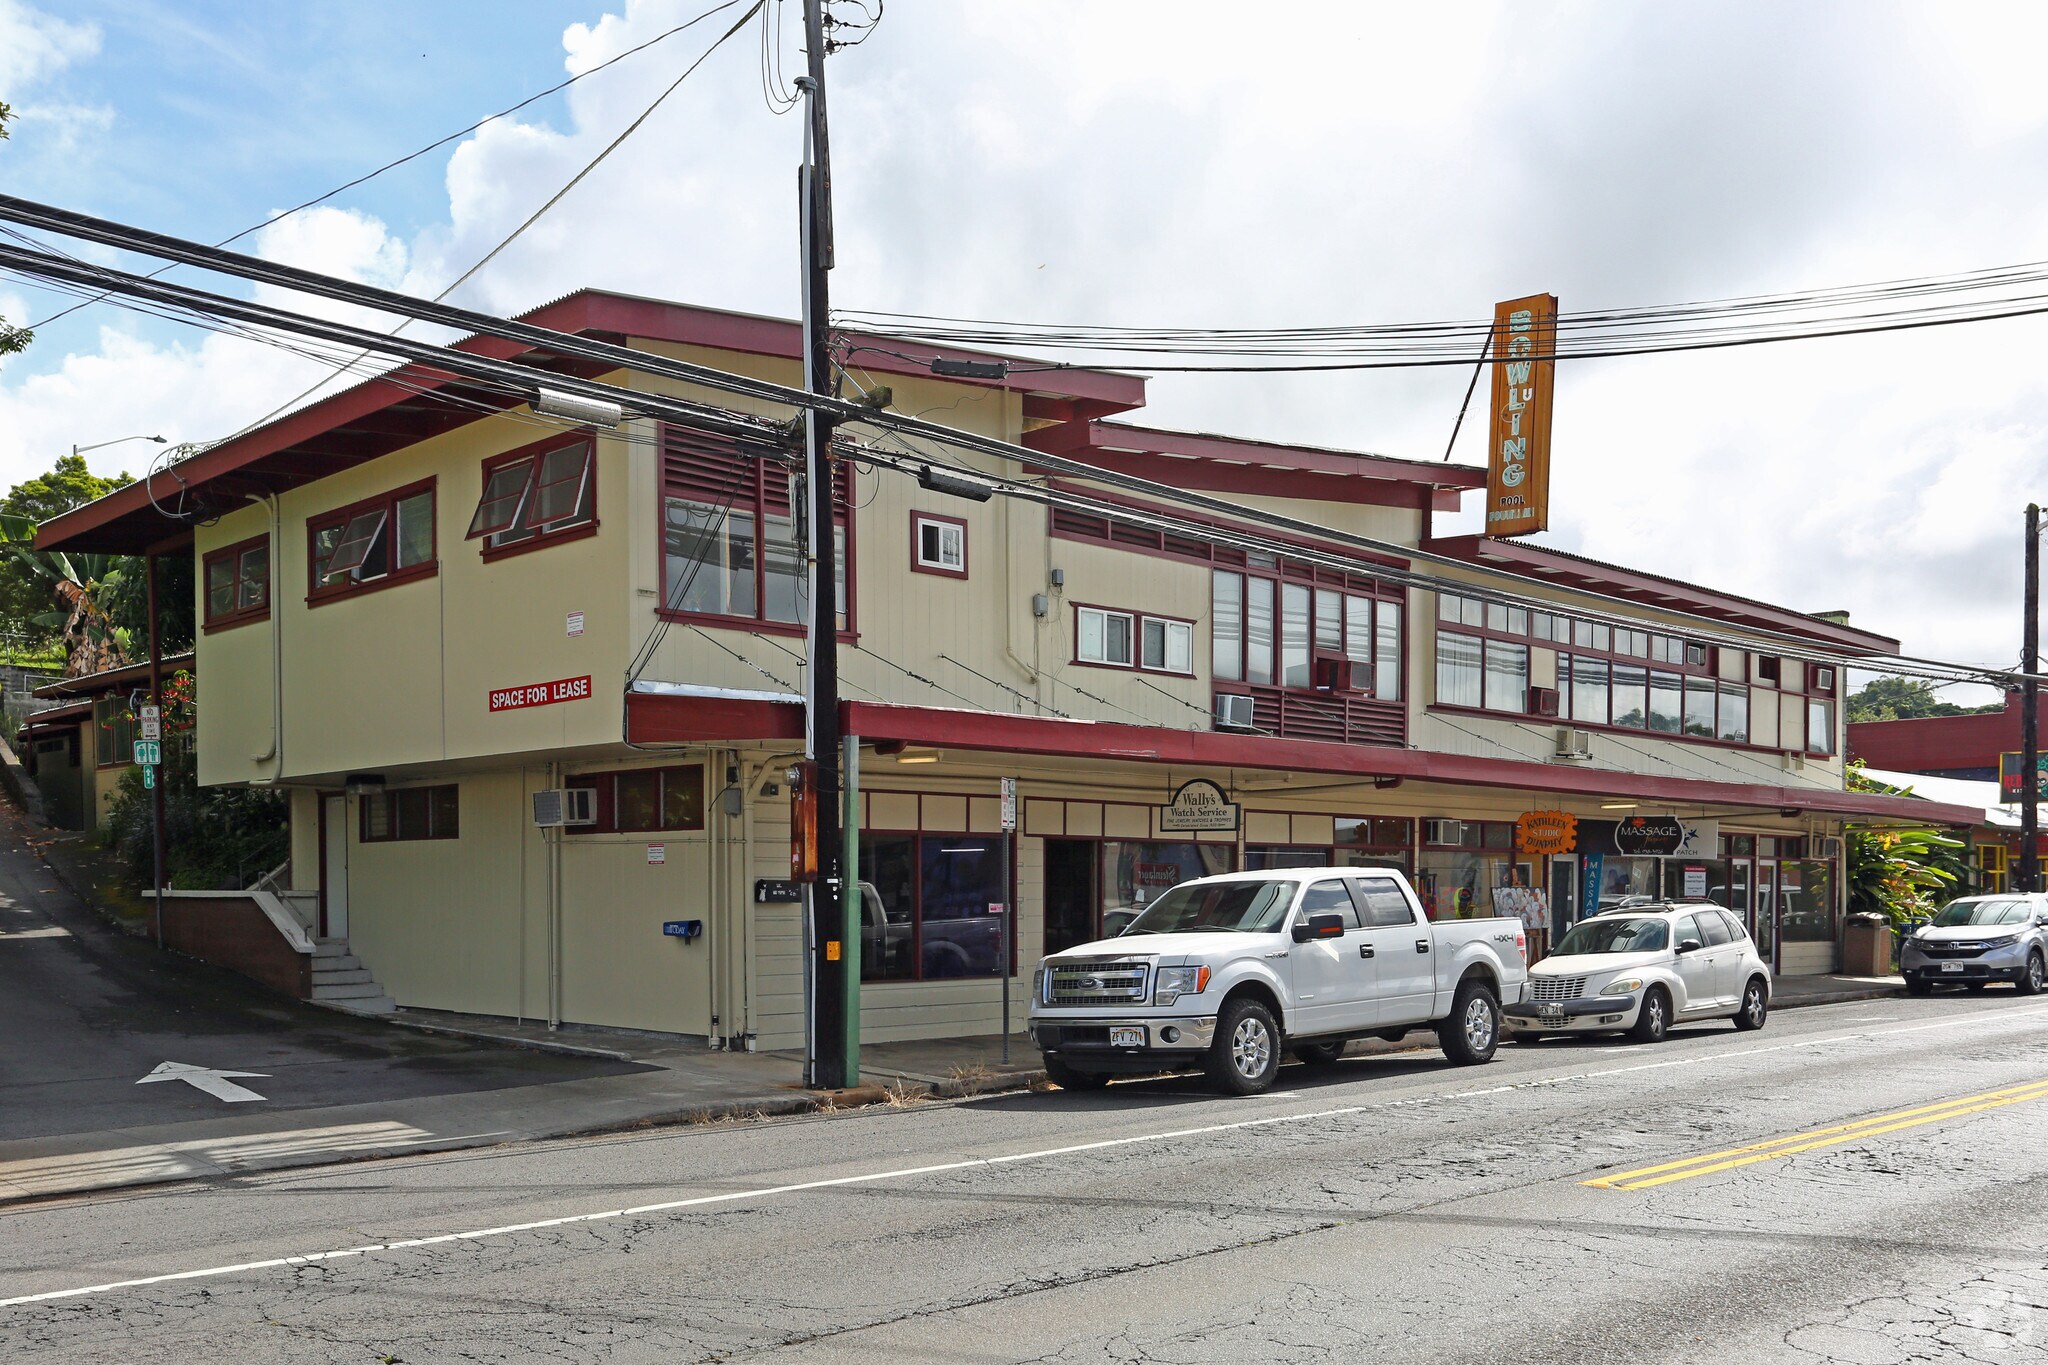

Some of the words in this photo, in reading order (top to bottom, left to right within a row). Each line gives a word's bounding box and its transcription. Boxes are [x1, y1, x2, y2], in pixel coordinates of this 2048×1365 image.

[1502, 310, 1532, 487] BOWLING
[1500, 495, 1526, 506] POOL
[492, 690, 524, 708] SPACE
[527, 687, 547, 703] FOR
[553, 680, 588, 699] LEASE
[146, 708, 153, 716] NO
[1182, 792, 1216, 808] Wally's
[1170, 808, 1196, 816] Watch
[1197, 807, 1228, 816] Service
[1526, 817, 1568, 830] KATHLEEN
[1532, 829, 1561, 837] STUDIO
[1620, 826, 1678, 836] MASSAGE
[1526, 836, 1563, 849] DUNPHY
[1585, 861, 1598, 917] MASSAG
[1112, 1032, 1125, 1041] ZFV
